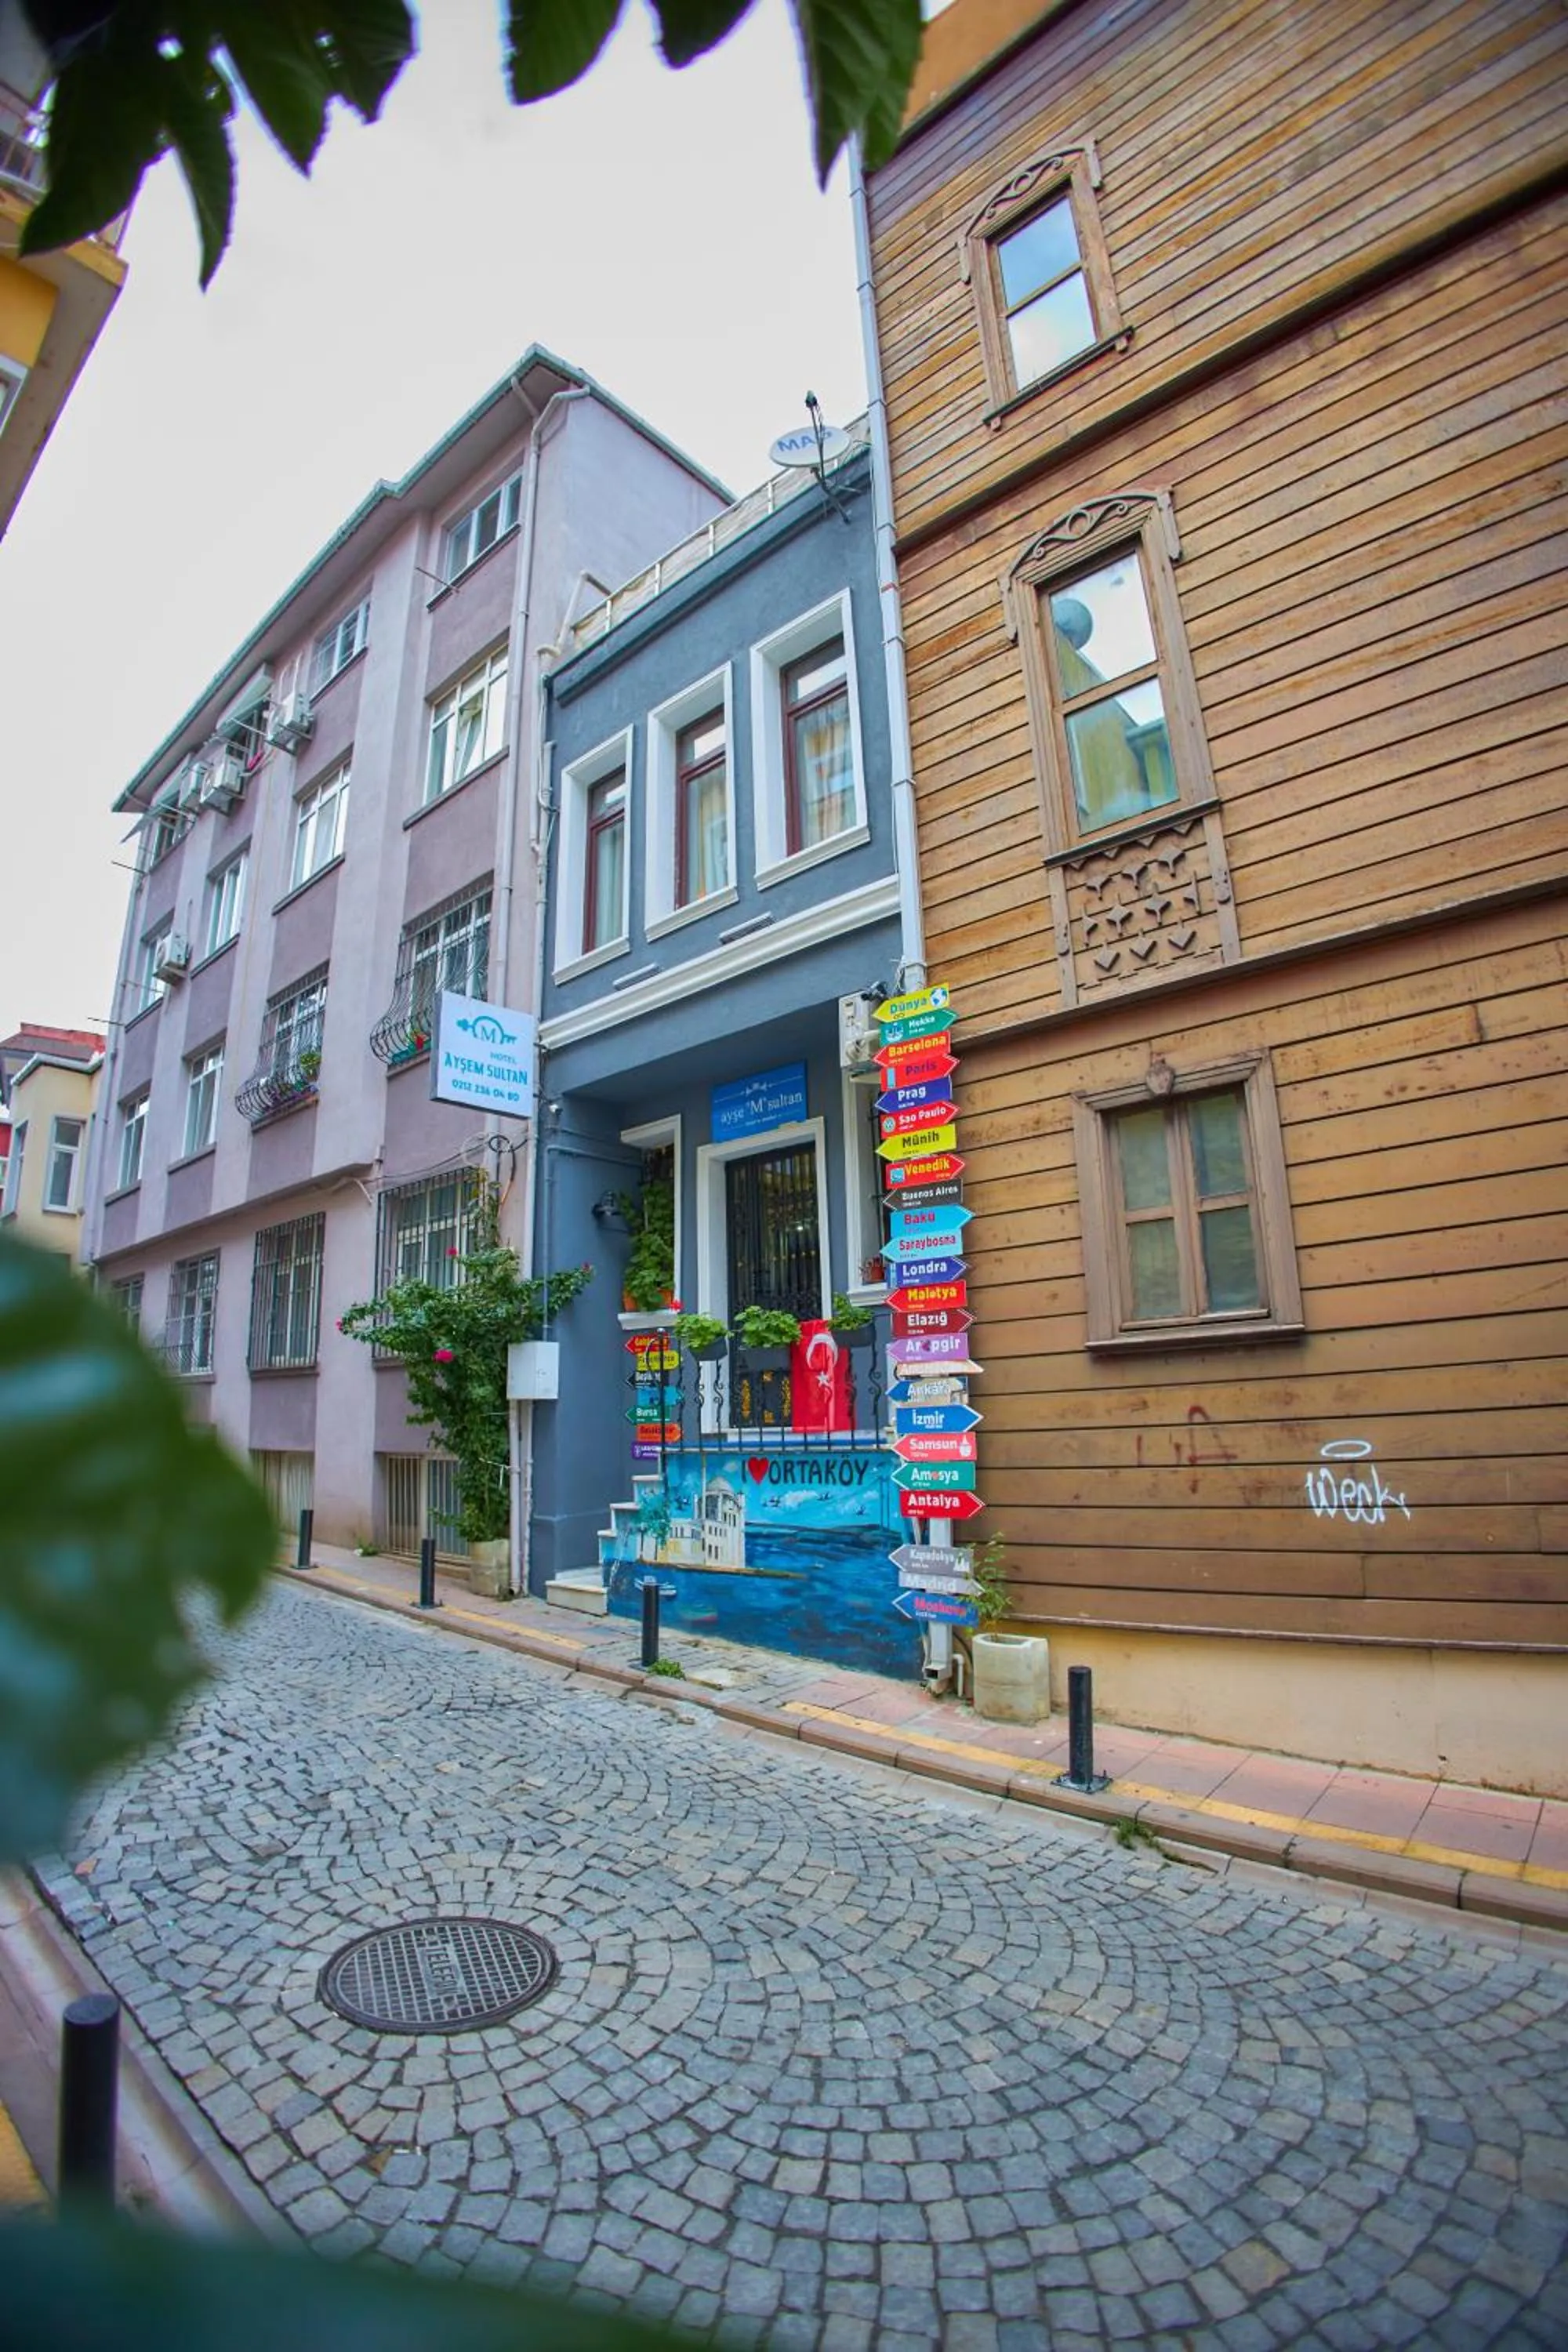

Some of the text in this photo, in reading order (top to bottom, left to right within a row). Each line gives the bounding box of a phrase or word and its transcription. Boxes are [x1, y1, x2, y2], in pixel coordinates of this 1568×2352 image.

[890, 998, 927, 1014] Dünya
[481, 1025, 497, 1044] M
[888, 1036, 947, 1058] Barselona
[445, 1051, 528, 1085] AYŞEM SULTAN
[906, 1060, 938, 1076] Paris
[768, 1092, 802, 1110] sultan
[898, 1087, 926, 1101] Prag
[918, 1106, 947, 1120] Paulo
[902, 1131, 940, 1148] Münih
[904, 1158, 951, 1176] Venedik
[902, 1185, 958, 1200] Buenos Aires
[899, 1235, 956, 1250] Saraybosna
[902, 1261, 947, 1276] Londra
[908, 1287, 957, 1301] Malatya
[907, 1311, 948, 1327] Elazığ
[636, 1407, 658, 1417] Bursa
[909, 1439, 957, 1450] Samsun
[768, 1454, 870, 1486] ORTAKÖY
[908, 1494, 960, 1509] Antalya
